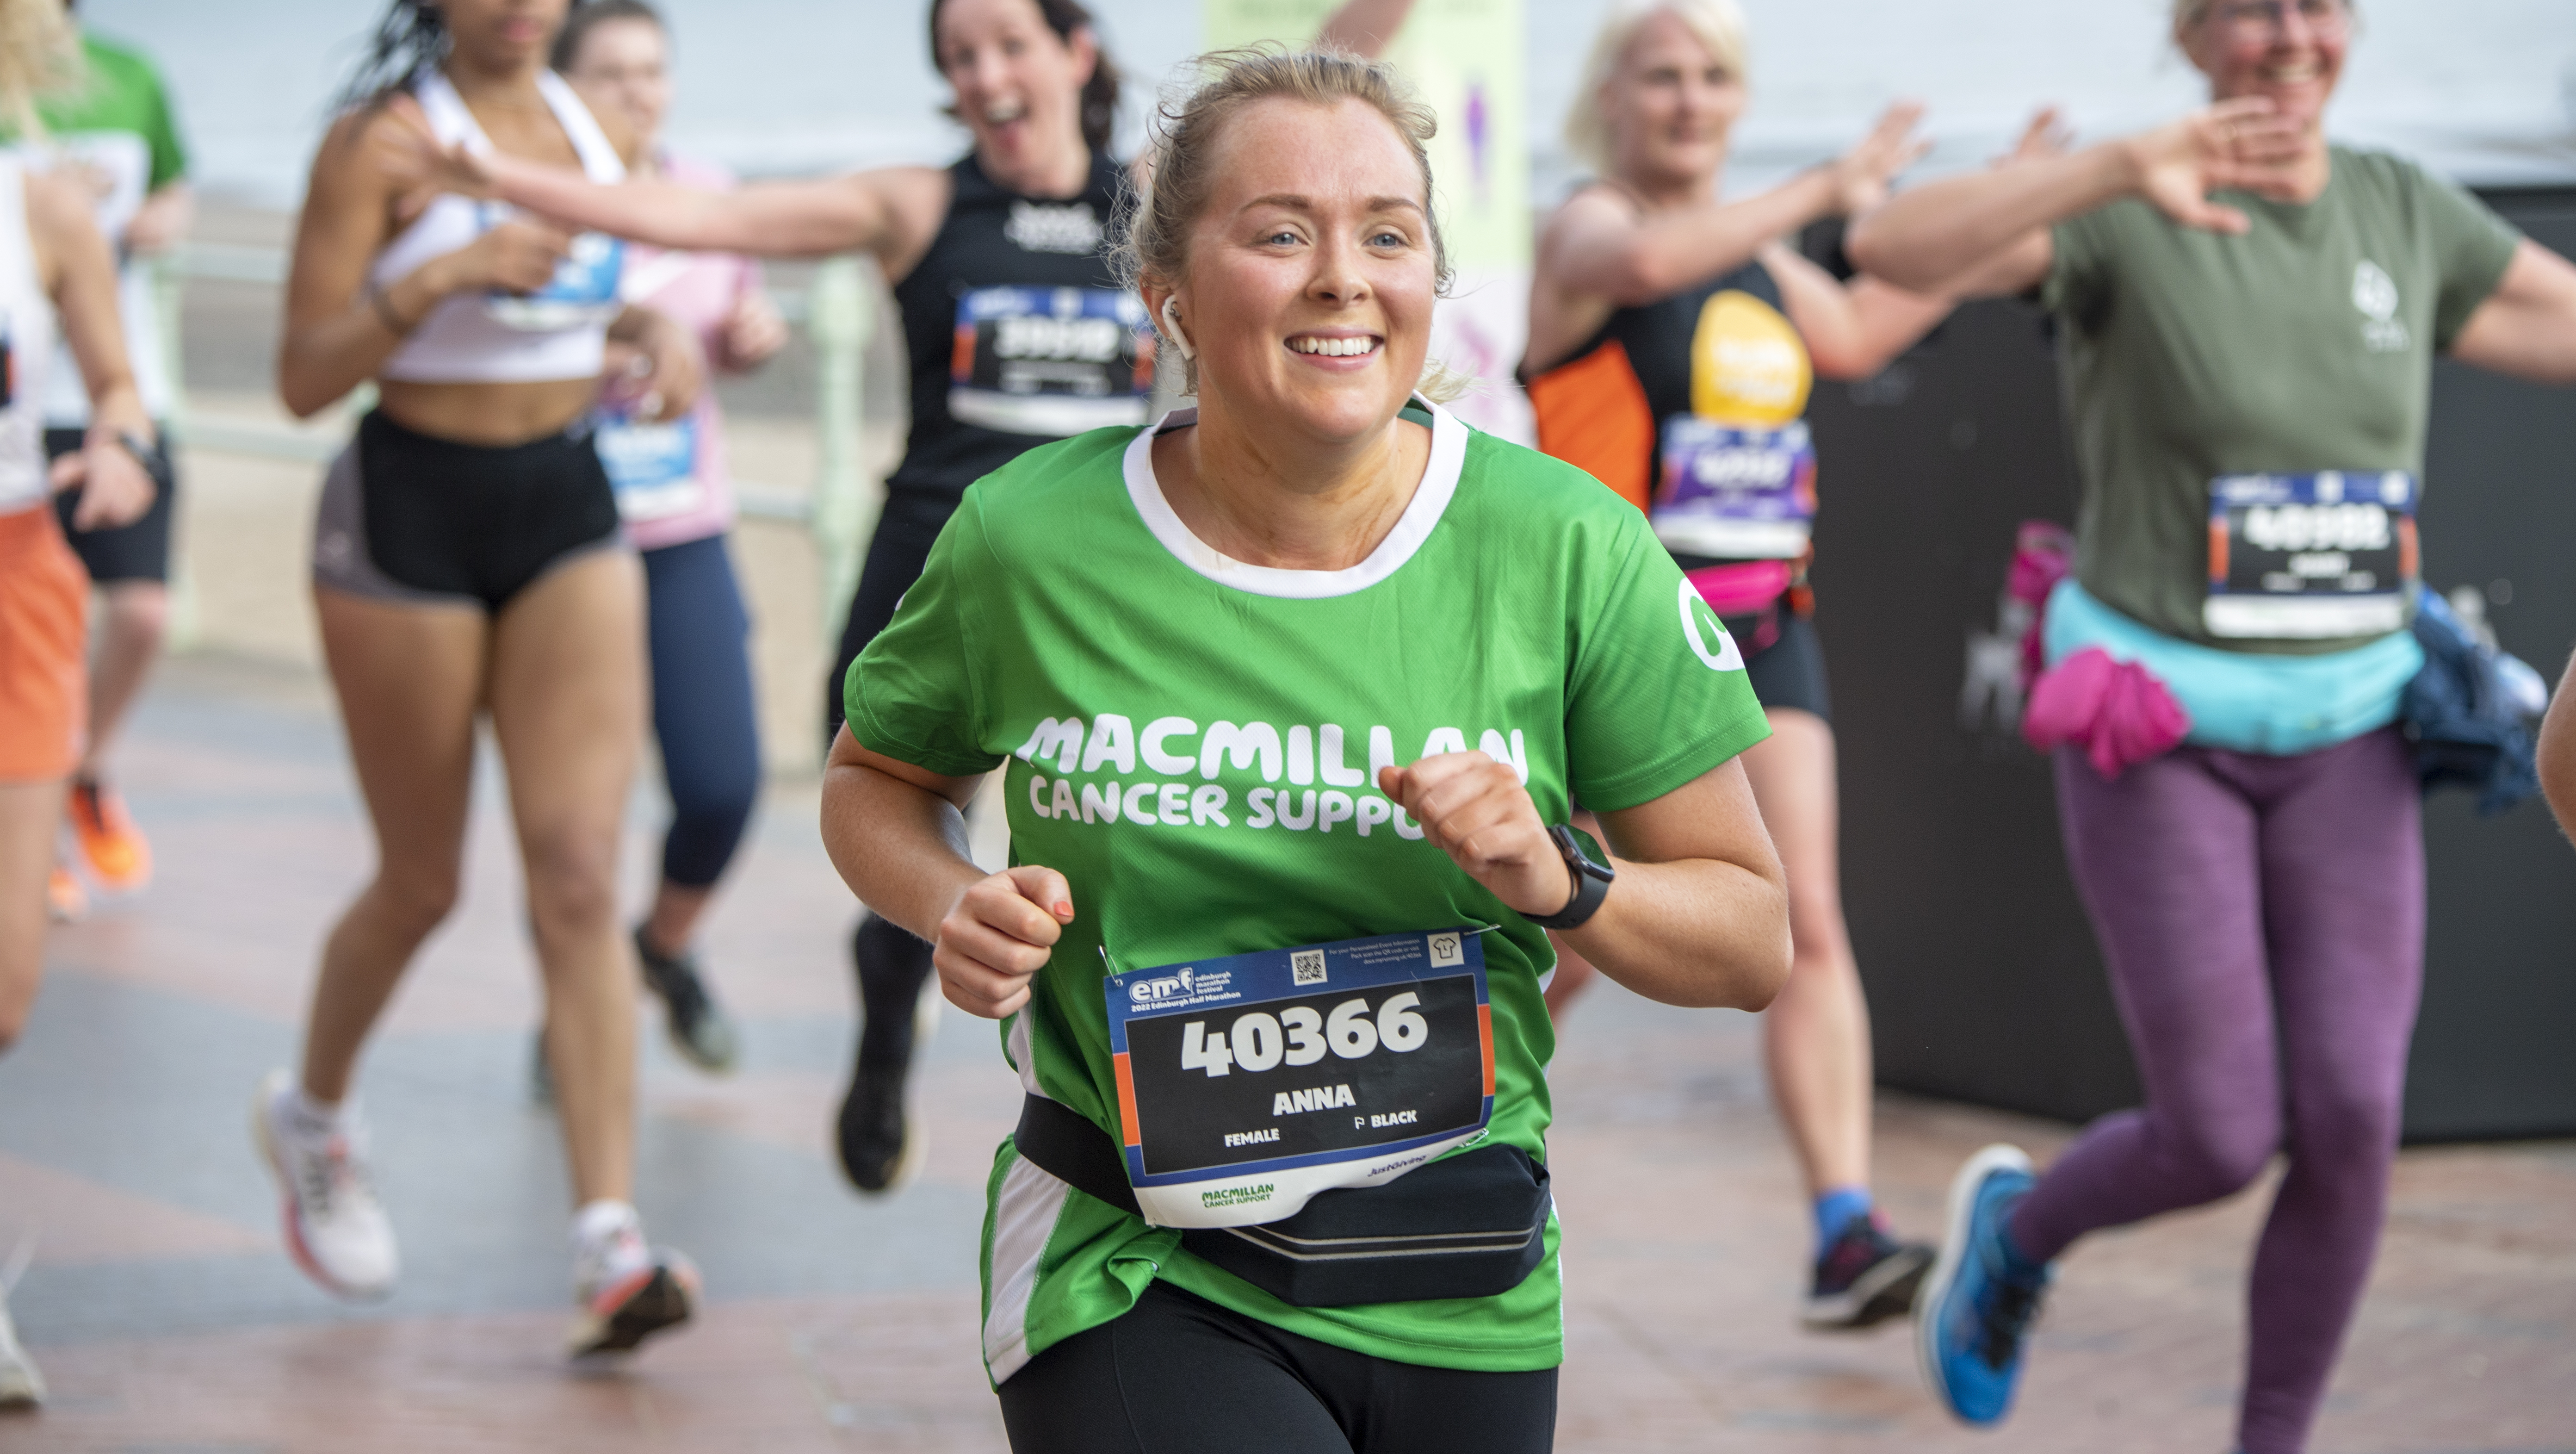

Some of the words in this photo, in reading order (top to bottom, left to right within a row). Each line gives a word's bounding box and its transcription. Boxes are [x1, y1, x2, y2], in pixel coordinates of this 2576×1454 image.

[1030, 775, 1230, 827] CANCER
[1130, 969, 1193, 1002] emf
[1195, 971, 1232, 982] edinburgh
[1196, 979, 1230, 988] marathon
[1196, 985, 1223, 994] festival
[1131, 1003, 1151, 1012] 2022
[1152, 998, 1189, 1009] Edinburgh
[1189, 995, 1205, 1004] Half
[1206, 991, 1241, 1002] Marathon
[1181, 991, 1428, 1078] 40366
[1273, 1084, 1356, 1116] ANNA
[1370, 1110, 1418, 1128] BLACK
[1224, 1128, 1280, 1147] FEMALE
[1202, 1183, 1274, 1202] MACMILLAN
[1204, 1198, 1235, 1208] CANCER
[1236, 1193, 1271, 1204] SUPPORT
